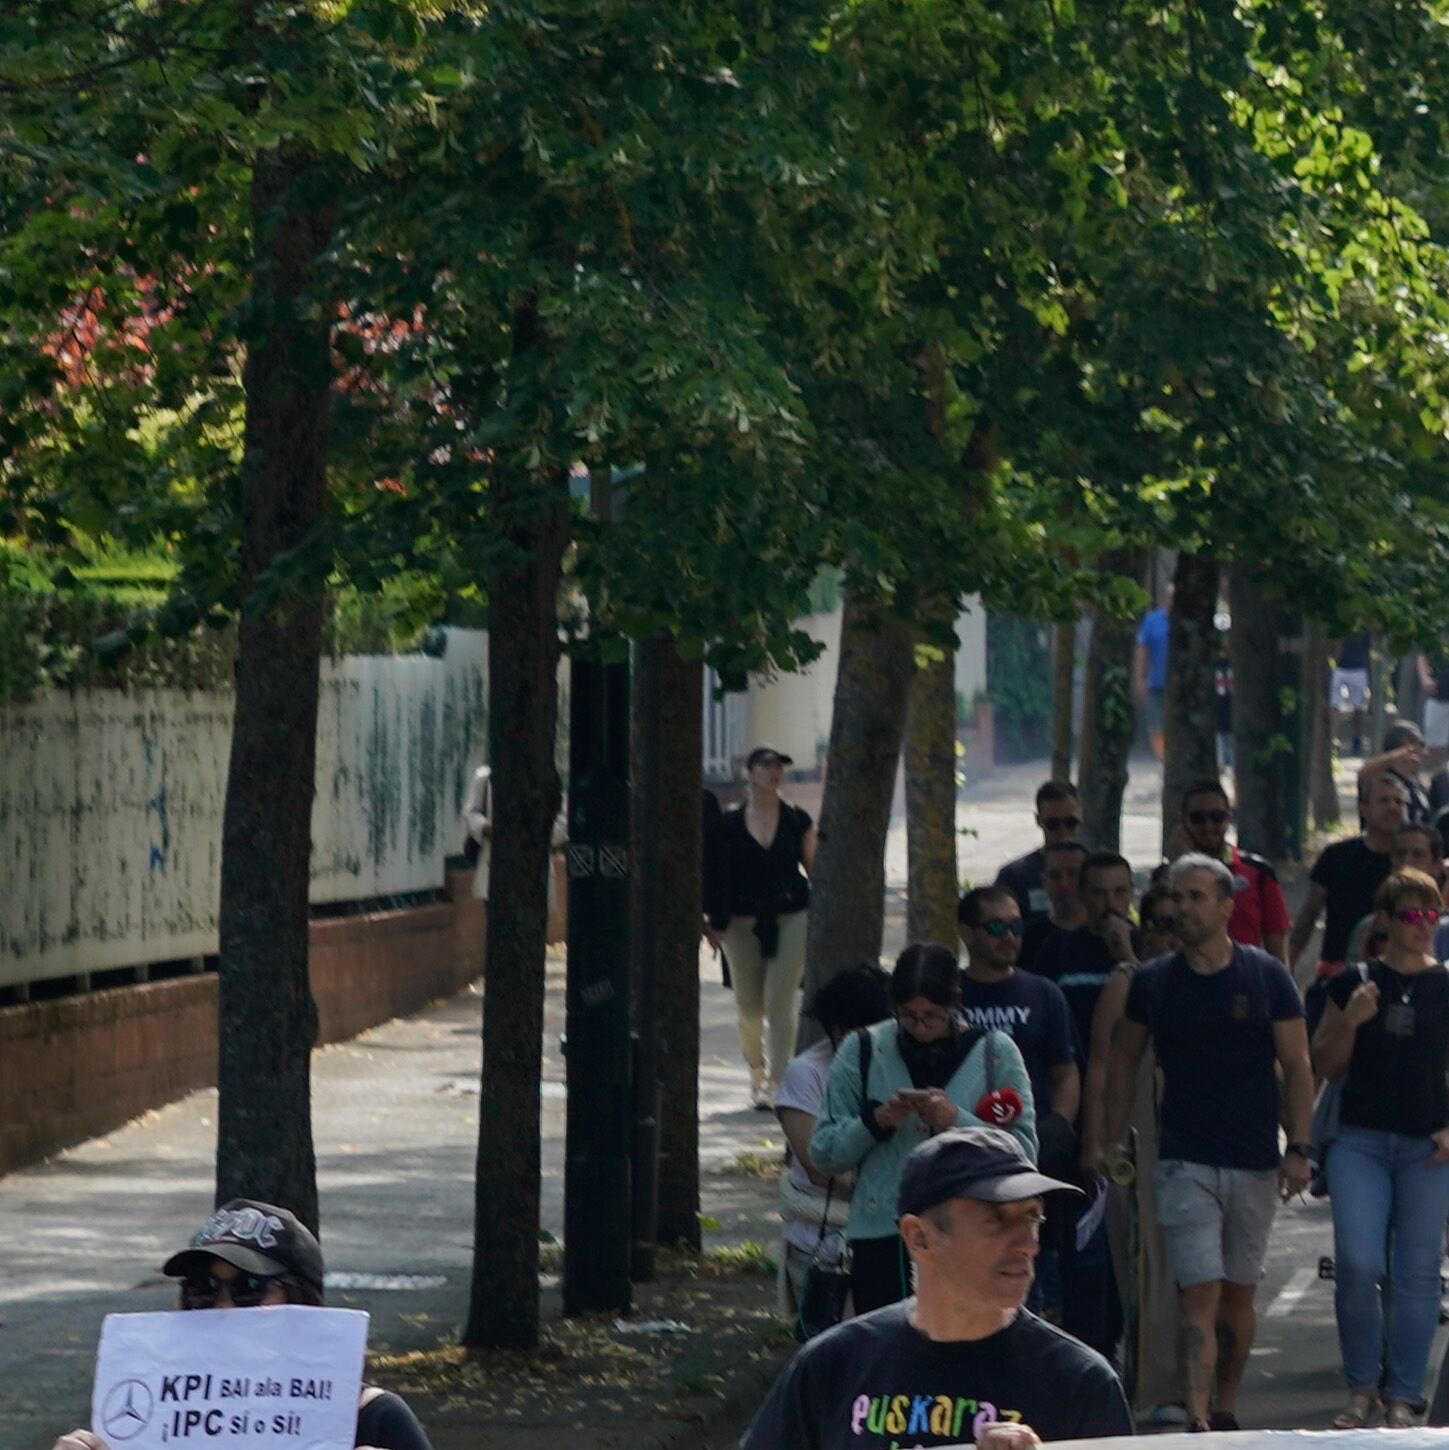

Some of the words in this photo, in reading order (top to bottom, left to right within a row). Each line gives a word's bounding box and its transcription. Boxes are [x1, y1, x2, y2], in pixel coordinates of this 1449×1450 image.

[160, 1374, 213, 1402] KPI
[220, 1378, 250, 1398] BAI
[254, 1377, 282, 1397] ala
[289, 1377, 333, 1400] BAI!
[254, 1419, 266, 1434] o
